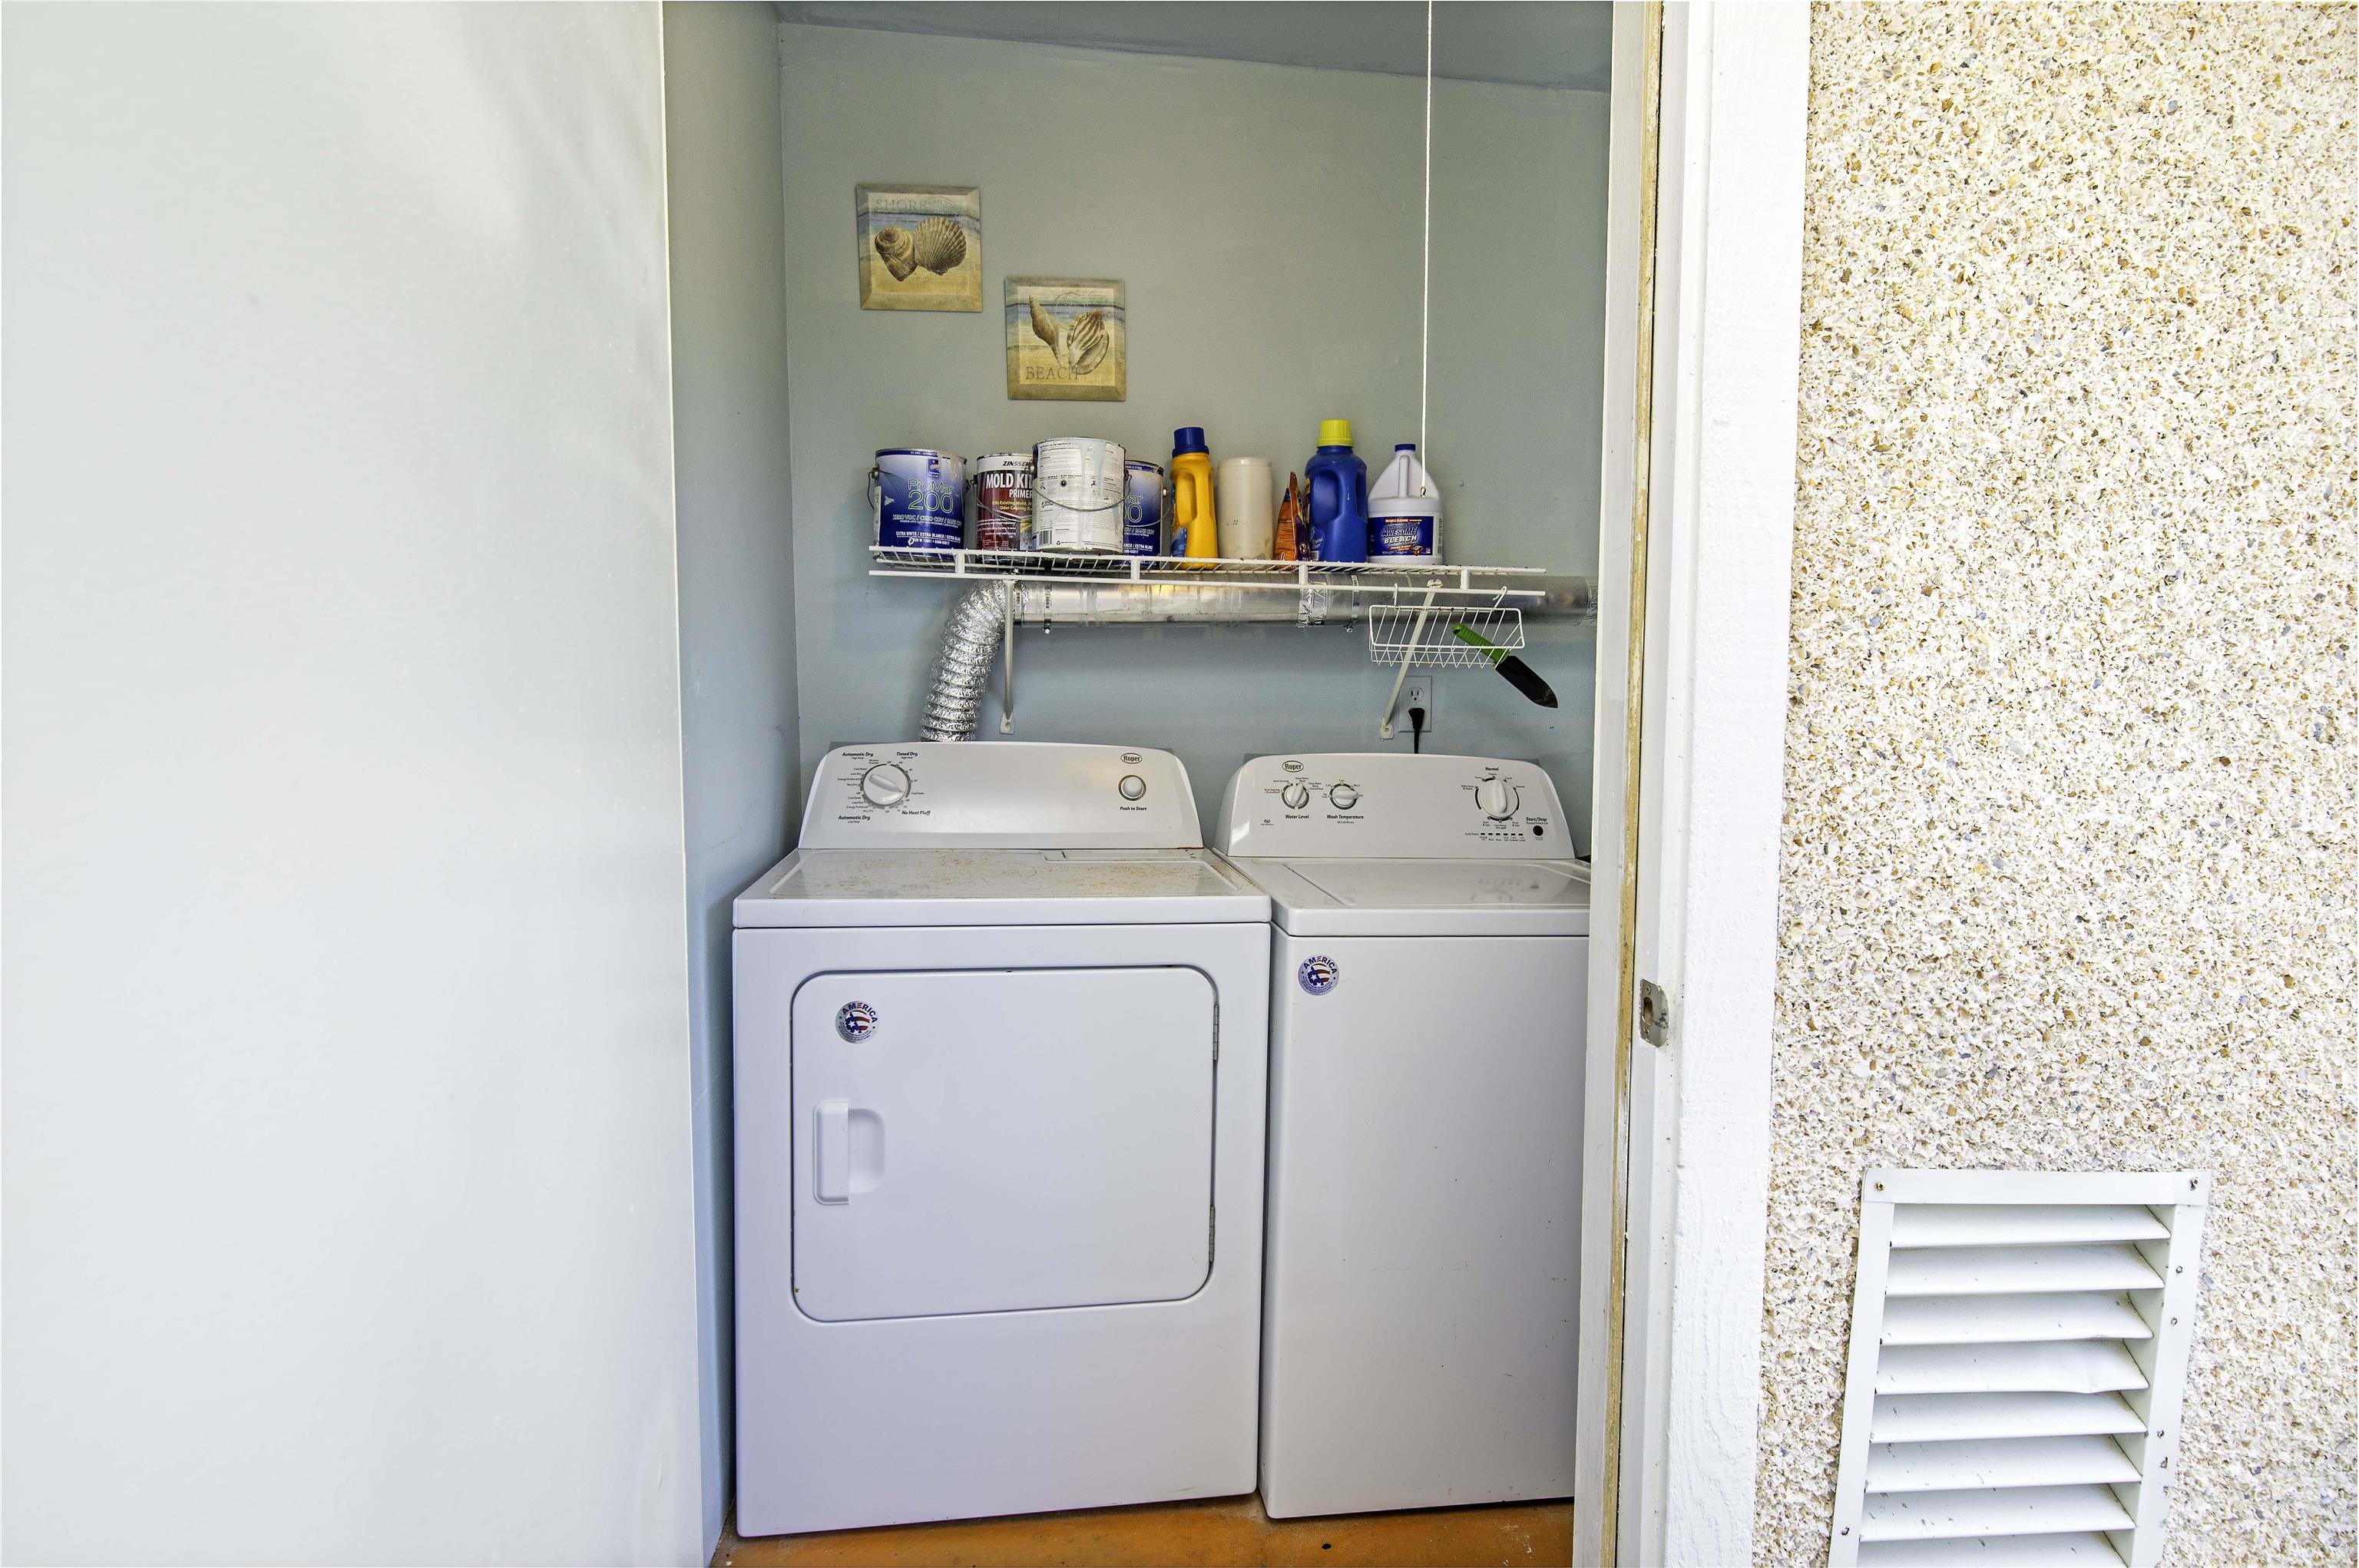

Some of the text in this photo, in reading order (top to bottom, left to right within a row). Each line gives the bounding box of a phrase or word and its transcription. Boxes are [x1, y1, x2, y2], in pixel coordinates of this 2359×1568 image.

[1026, 366, 1079, 380] BEACH
[908, 478, 955, 494] ProMar
[986, 473, 1014, 489] MOLD
[908, 490, 954, 514] 200
[1381, 526, 1418, 537] AWESOME
[1385, 535, 1417, 544] BLEACH
[1303, 955, 1337, 974] AMERICA
[842, 1003, 878, 1023] AMERICA
